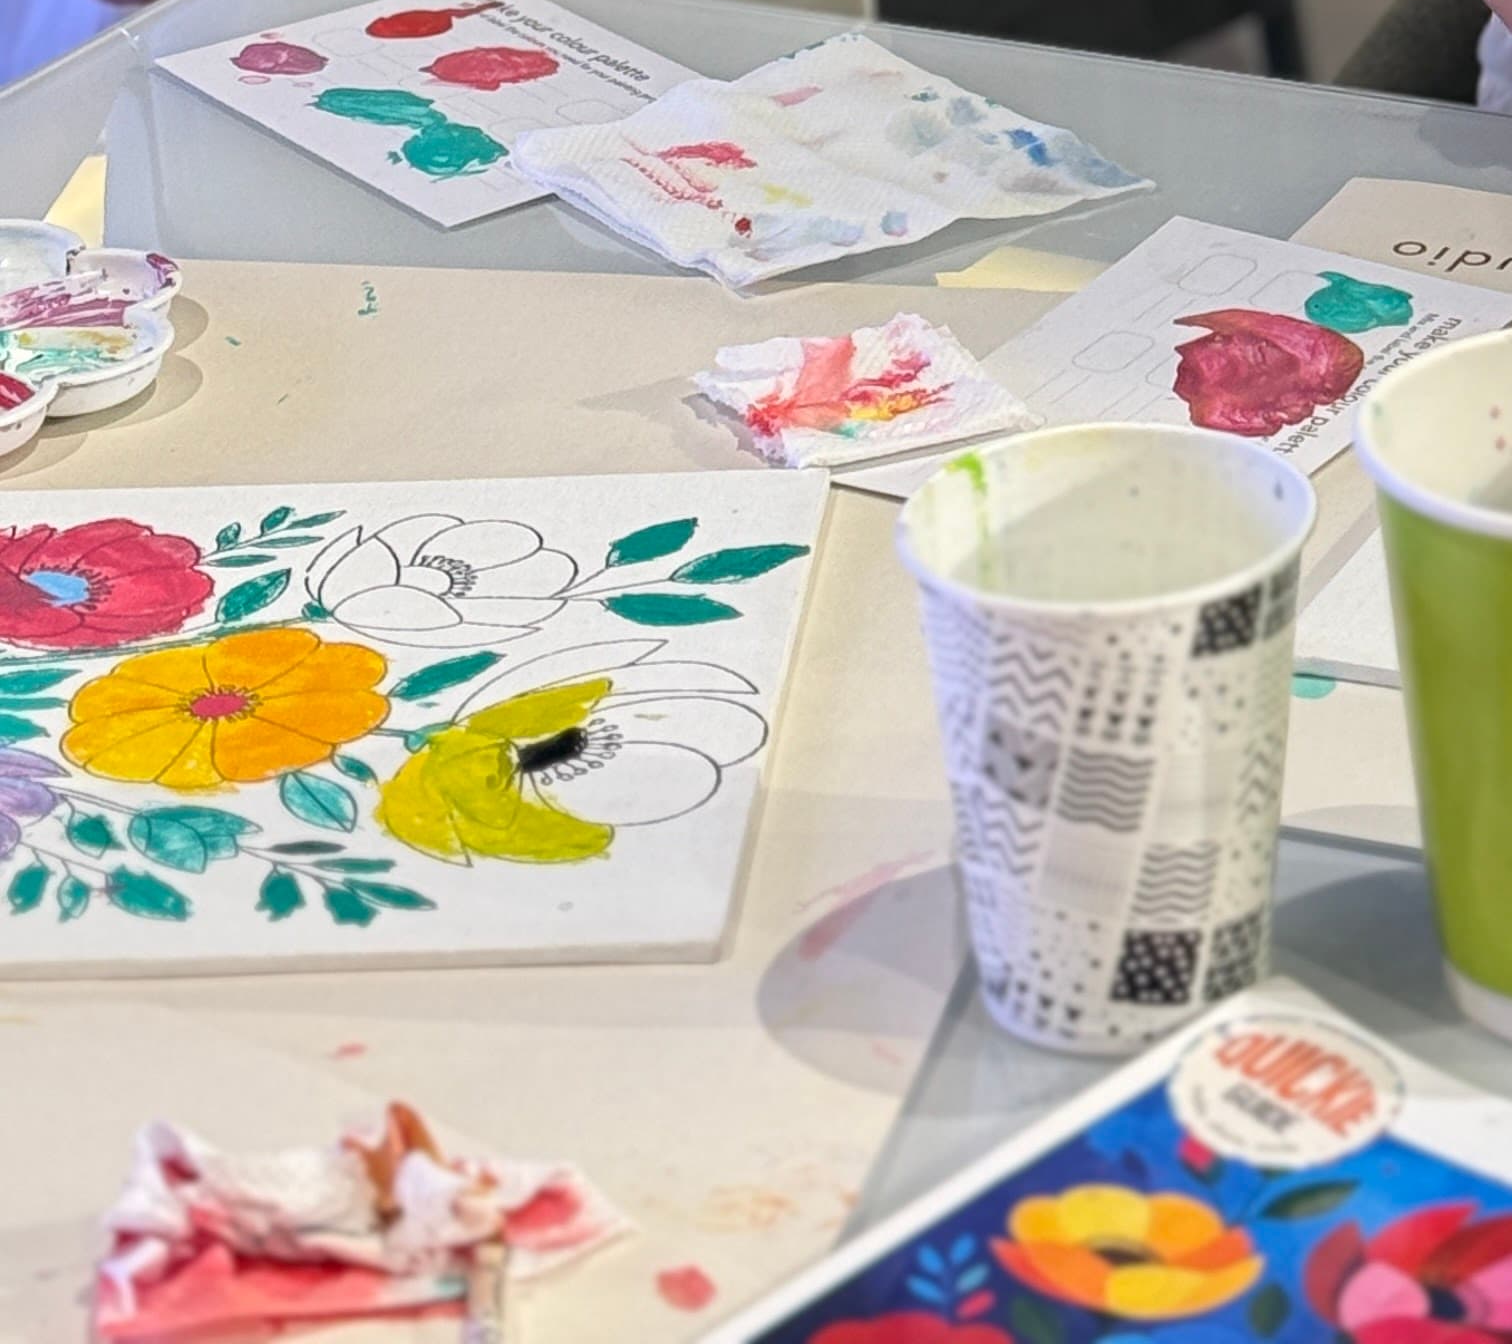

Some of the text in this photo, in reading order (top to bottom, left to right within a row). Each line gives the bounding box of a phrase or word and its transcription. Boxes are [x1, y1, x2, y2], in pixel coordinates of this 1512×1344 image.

[516, 15, 553, 32] your
[550, 31, 598, 55] colour
[588, 54, 651, 82] palette
[1272, 317, 1462, 454] make your colour palett
